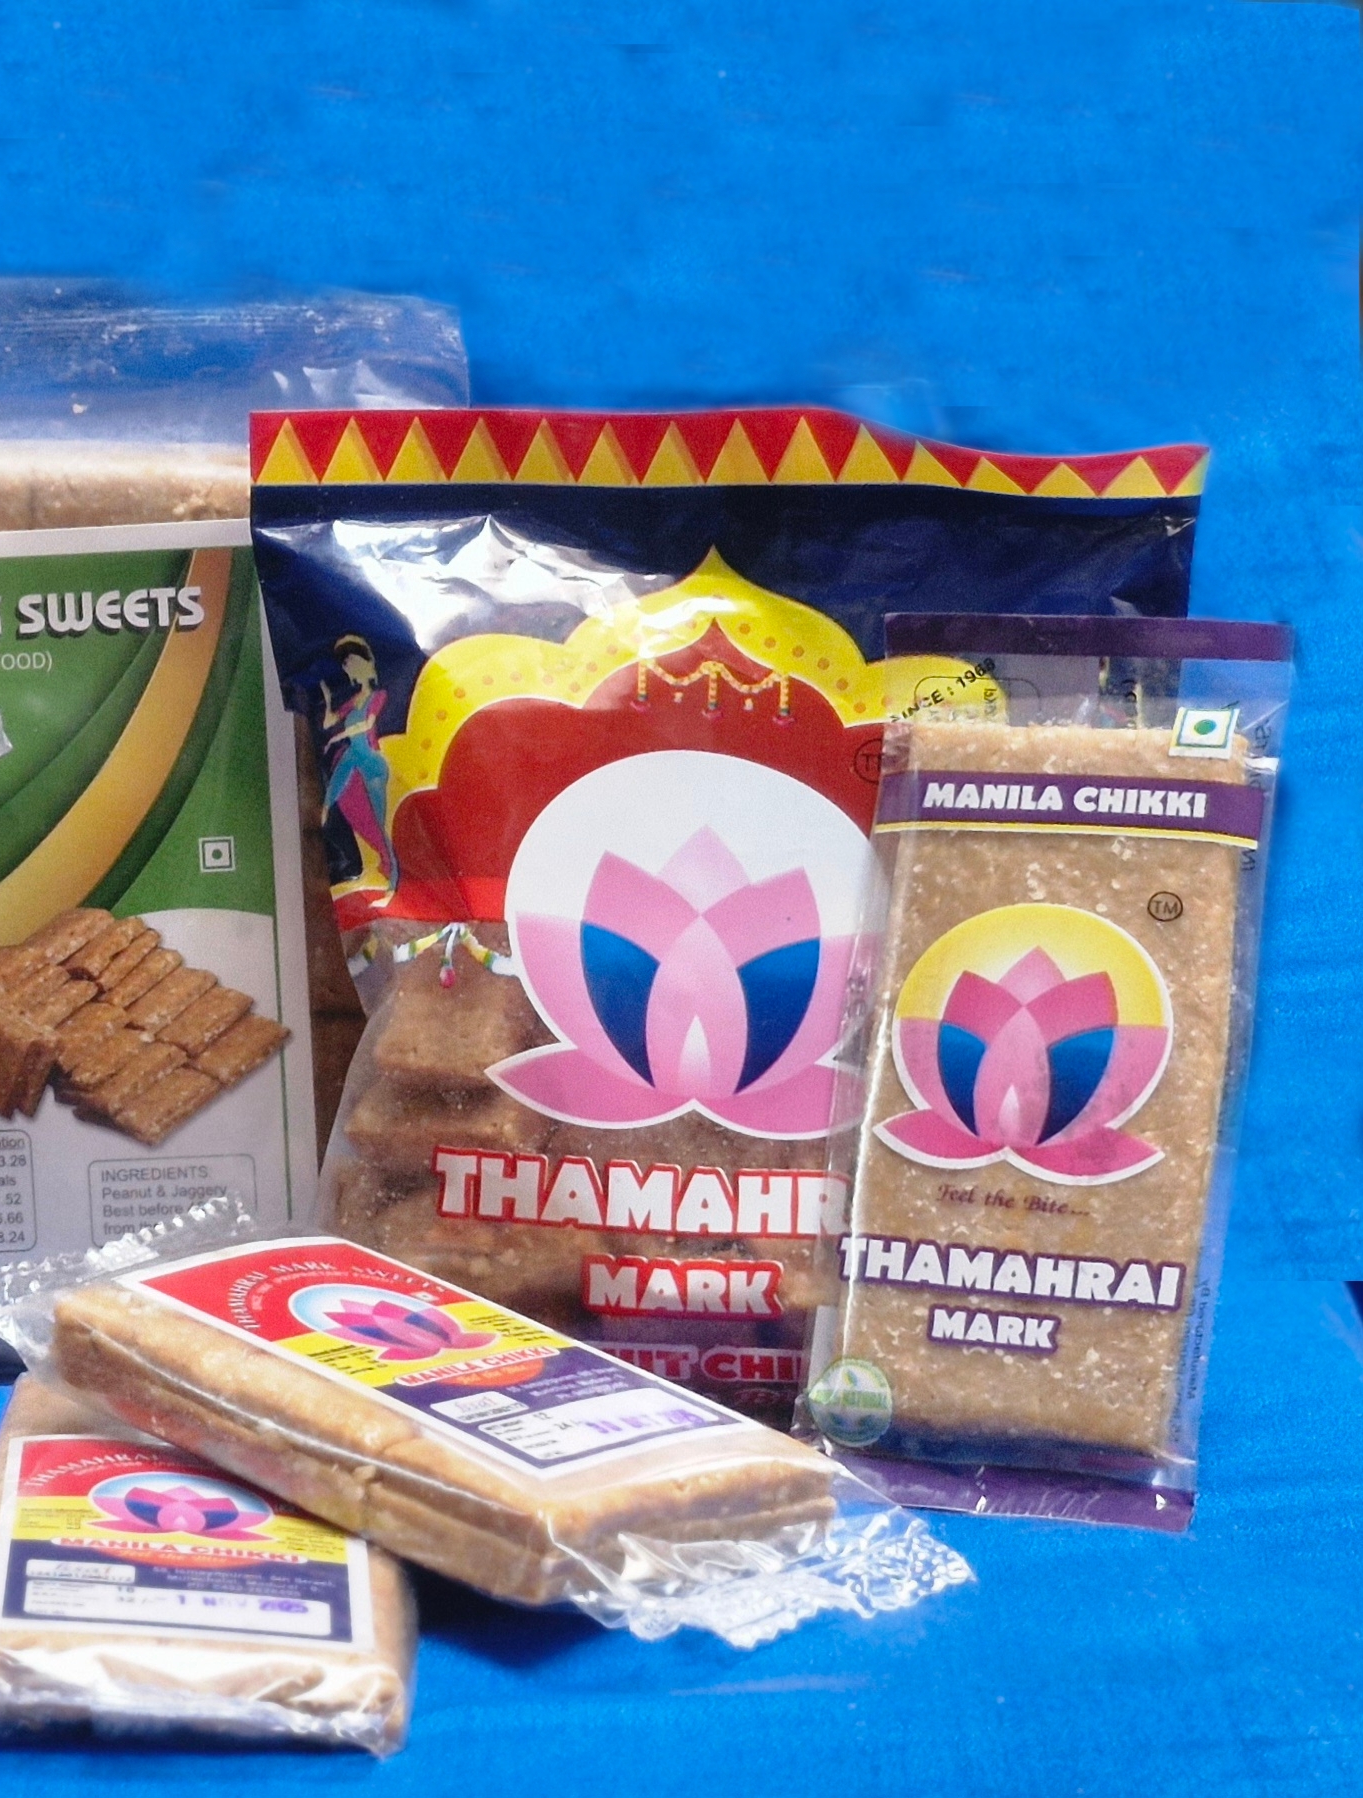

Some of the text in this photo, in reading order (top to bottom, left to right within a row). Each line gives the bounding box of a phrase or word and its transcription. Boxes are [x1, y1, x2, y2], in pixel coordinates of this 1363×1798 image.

[18, 586, 205, 637] SWEETS
[923, 782, 1208, 820] MANILA CHIKKI
[1153, 899, 1179, 916] TM
[102, 1184, 228, 1200] Peanut & Jaggery
[102, 1204, 134, 1218] Best
[138, 1202, 184, 1217] before
[434, 1150, 851, 1238] THAMAHR
[984, 1187, 1017, 1210] the
[587, 1259, 774, 1318] MARK
[839, 1236, 1185, 1308] THAMAHRAI
[930, 1309, 1057, 1350] MARK
[400, 1361, 480, 1386] MANILA
[491, 1345, 558, 1368] CHIKKI
[58, 1537, 300, 1564] MANILA CHIKKI
